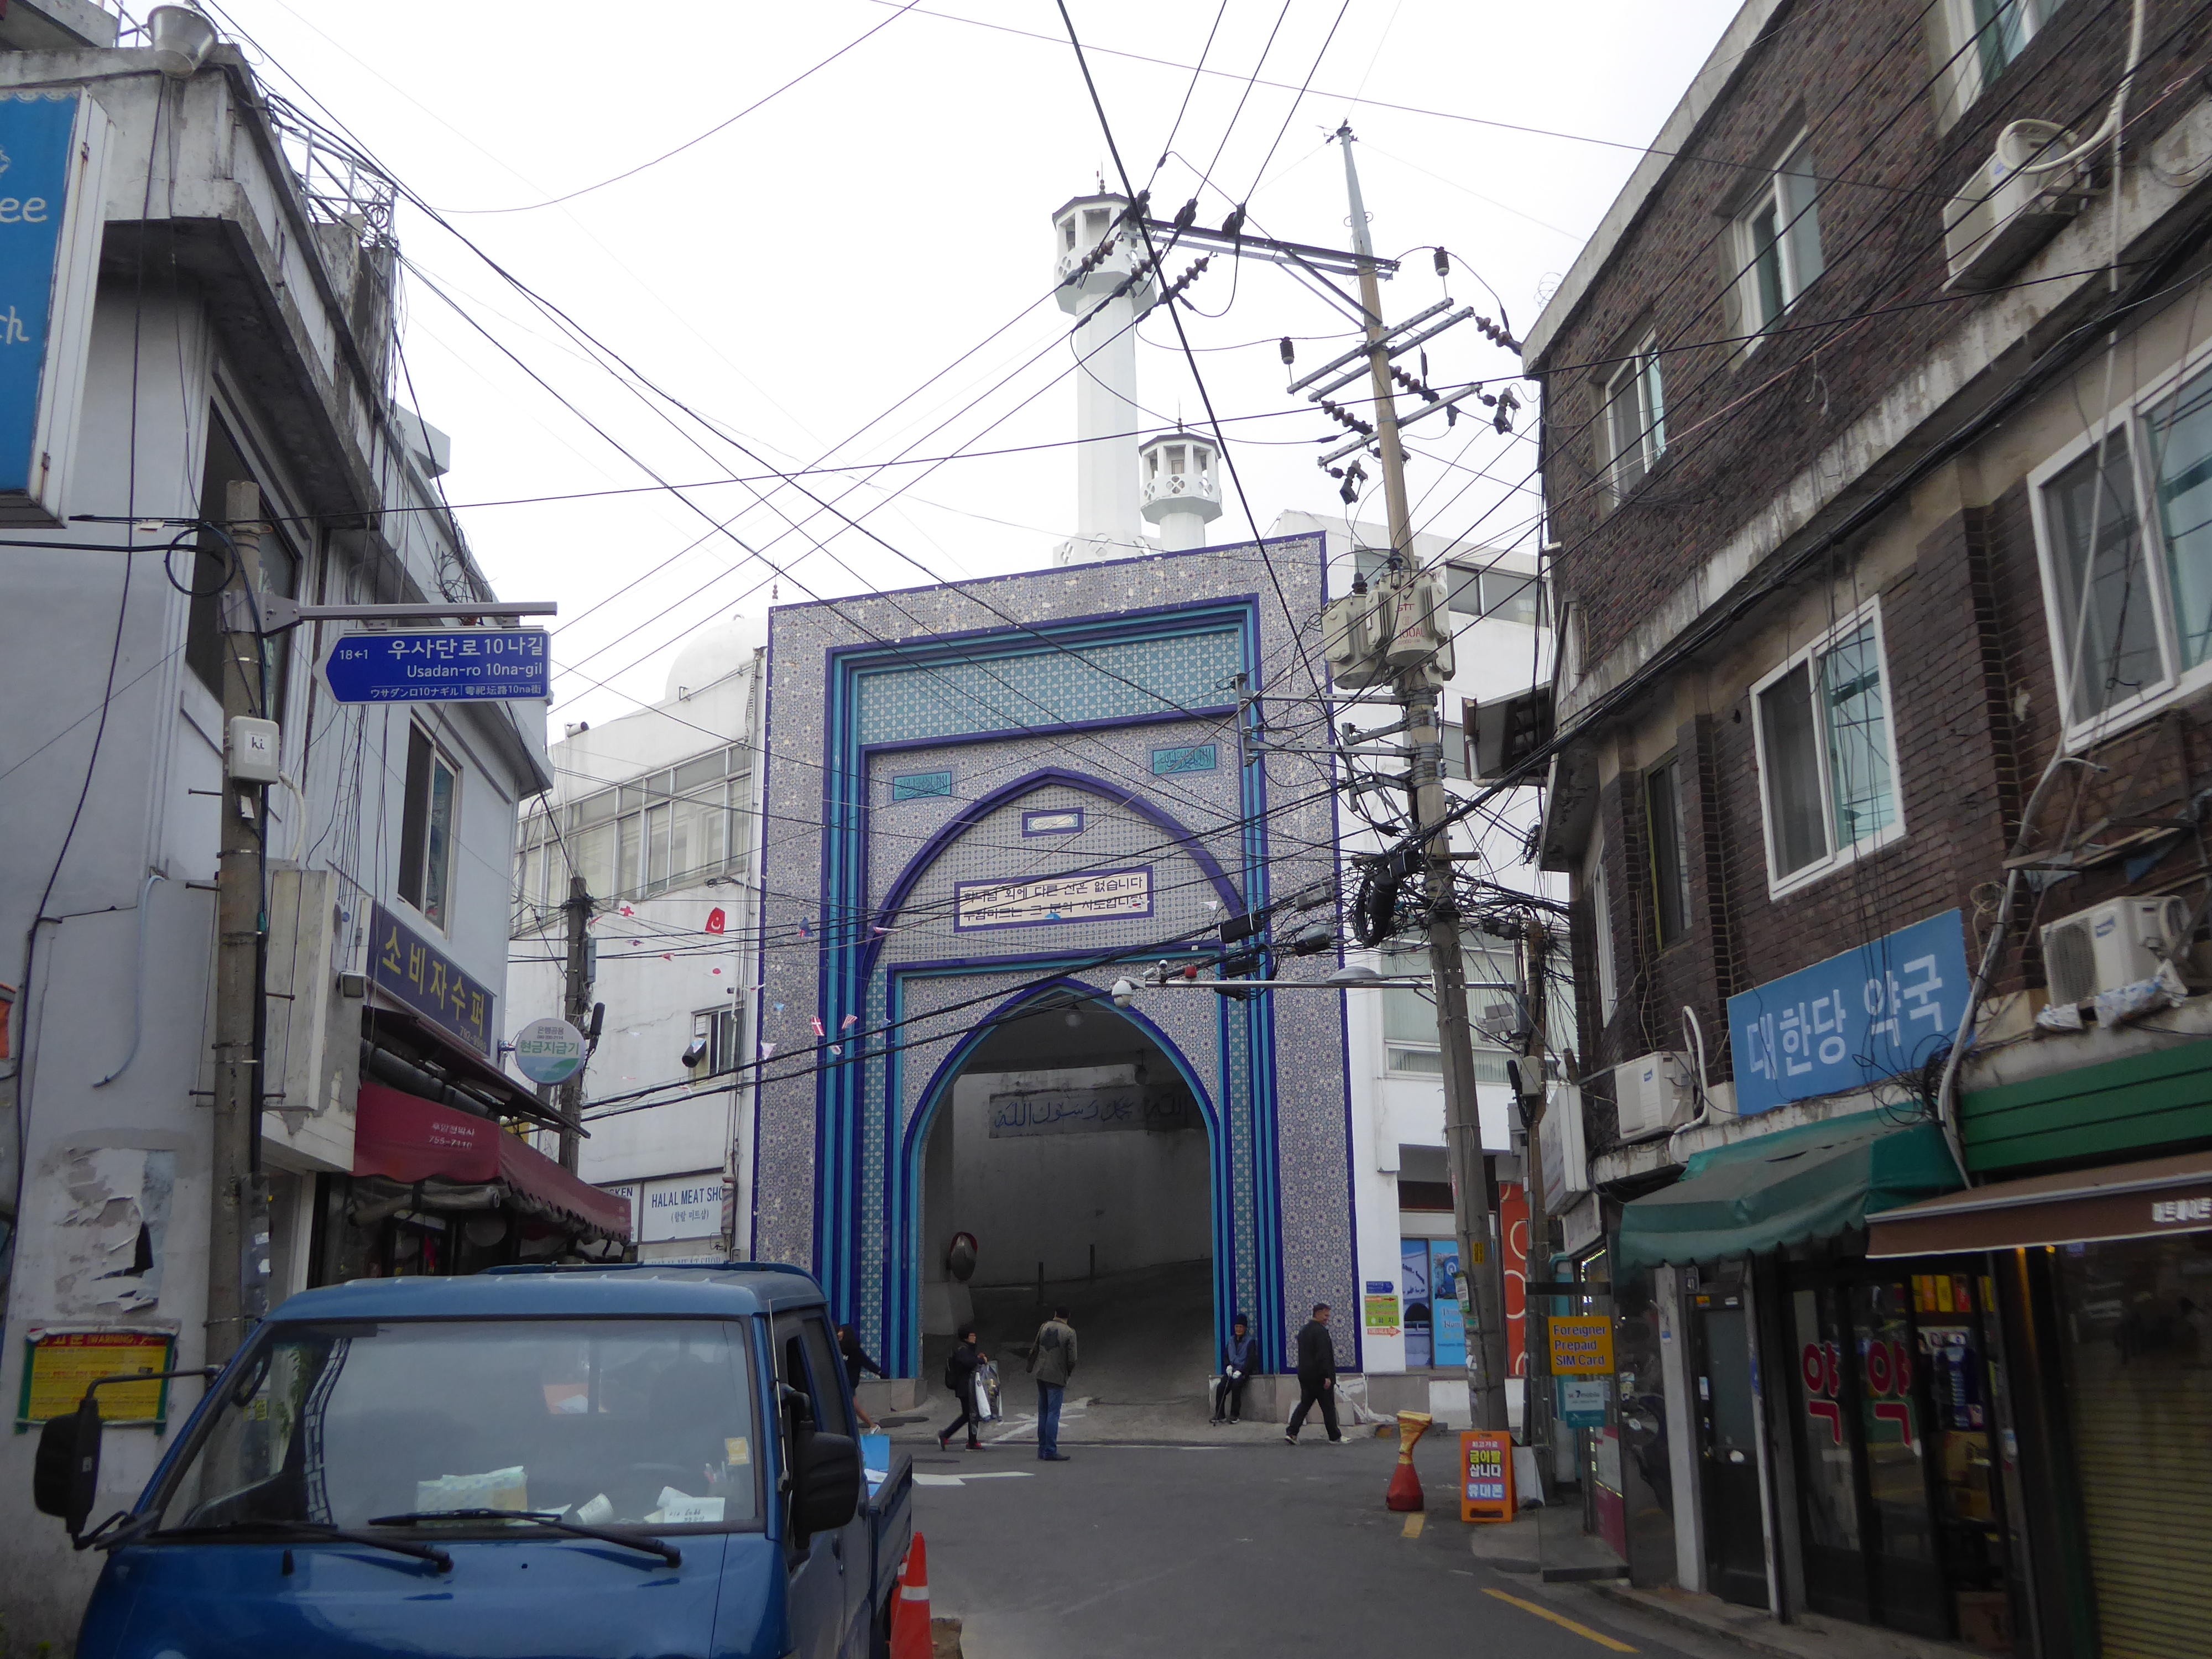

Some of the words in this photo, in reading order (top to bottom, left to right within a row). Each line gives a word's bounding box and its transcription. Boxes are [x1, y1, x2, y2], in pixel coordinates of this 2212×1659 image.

[407, 664, 481, 678] Usadan-ro
[486, 662, 542, 677] 10na-gil
[1005, 886, 1028, 900] 외에
[1034, 885, 1058, 898] 다른
[1094, 876, 1143, 892] 없습니다
[1030, 904, 1042, 916] 그
[382, 926, 485, 1037] 소비자수퍼
[1746, 989, 1846, 1080] 대한당
[1863, 953, 1944, 1047] 약국
[520, 1040, 580, 1055] 현금지급기
[651, 1191, 679, 1208] HALAL
[681, 1188, 705, 1206] MEAT
[707, 1185, 723, 1202] SHO
[1553, 1324, 1606, 1337] Foreigner
[1554, 1339, 1598, 1352] Prepaid
[1556, 1355, 1575, 1365] SIM
[1578, 1354, 1605, 1365] Card
[1802, 1341, 1843, 1446] 약
[1867, 1340, 1912, 1447] 약
[1469, 1464, 1502, 1478] 삽니다
[1468, 1484, 1504, 1499] 휴대폰
